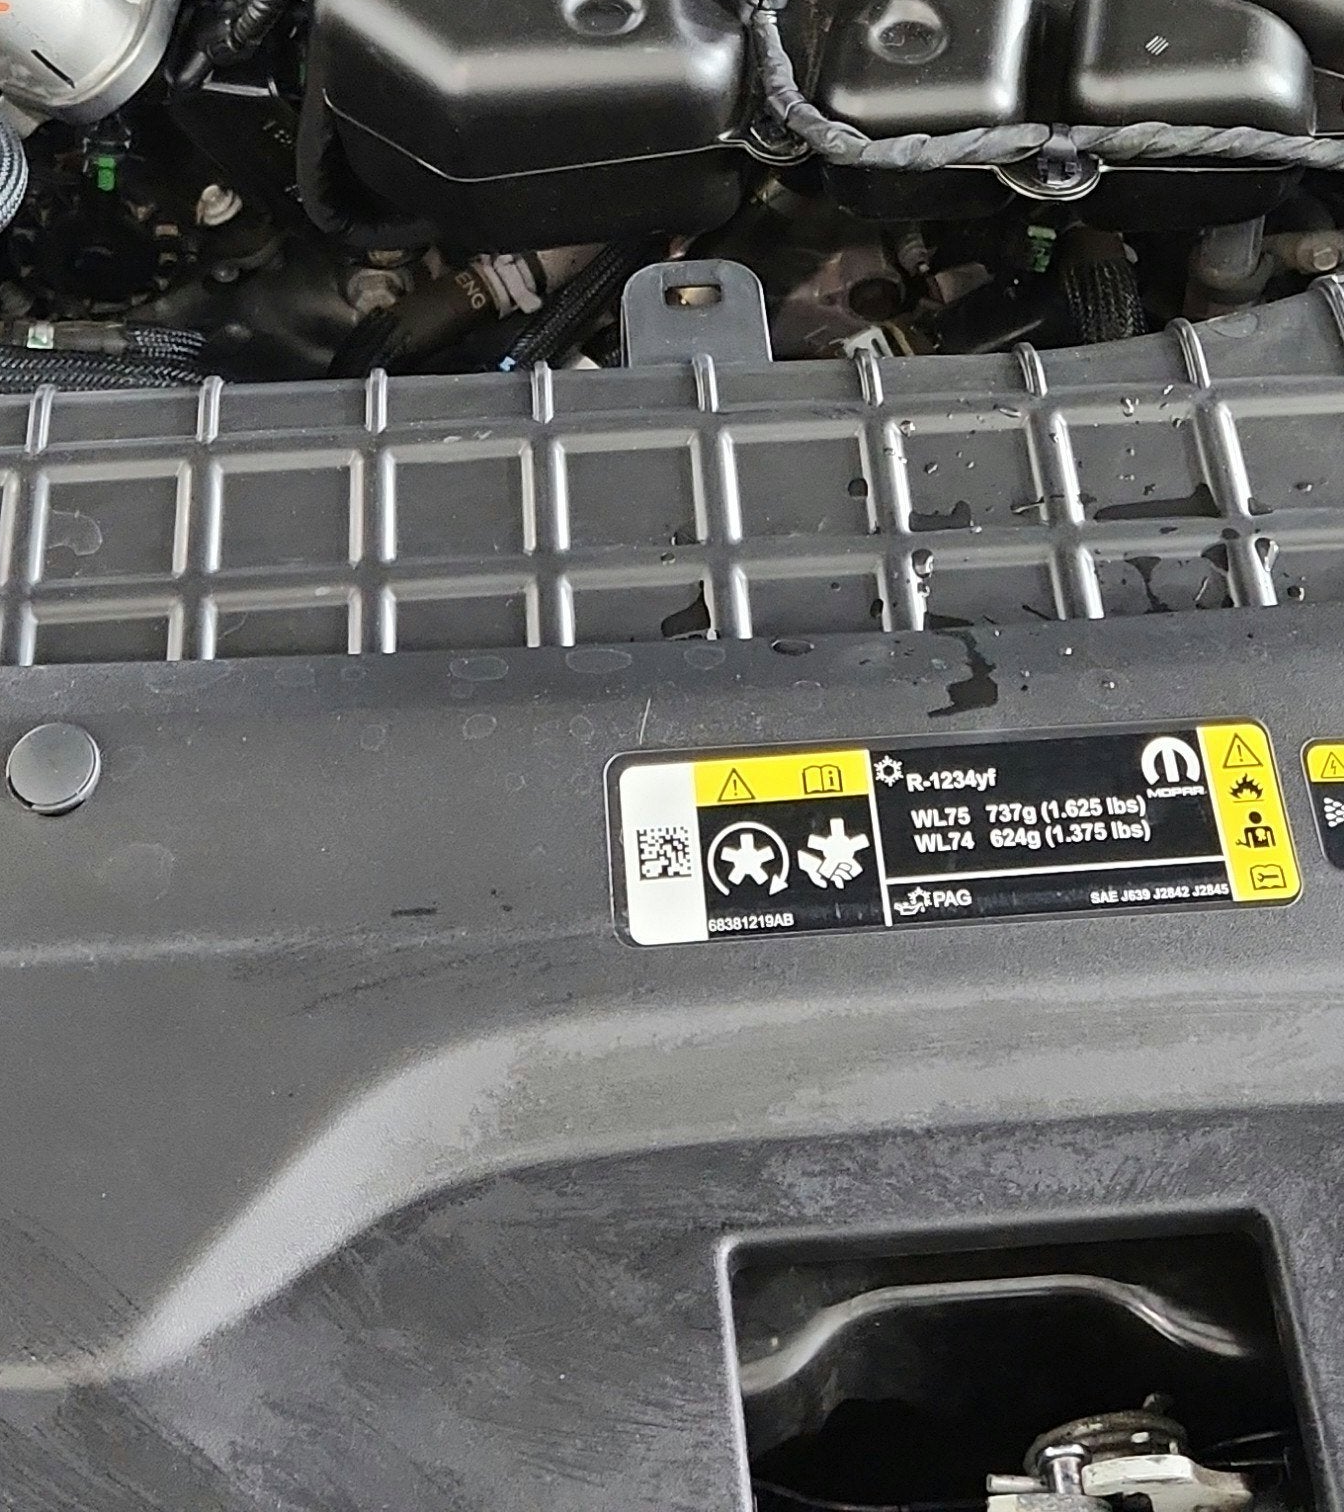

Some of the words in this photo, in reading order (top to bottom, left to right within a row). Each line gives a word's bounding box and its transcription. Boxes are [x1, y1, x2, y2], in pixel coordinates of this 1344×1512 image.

[454, 272, 486, 310] ENG
[906, 767, 996, 793] R-1234yf
[1146, 786, 1205, 799] MOPAR
[911, 806, 971, 828] WL75
[985, 803, 1038, 825] 737g
[1041, 798, 1103, 823] (1.625
[1105, 795, 1146, 818] lbs)
[914, 831, 975, 853] WL74
[990, 827, 1042, 850] 624g
[1045, 822, 1107, 848] (1.375
[1110, 819, 1151, 842] lbs)
[933, 889, 973, 908] PAG
[1090, 889, 1118, 904] SAE
[1120, 888, 1152, 902] J639
[1153, 885, 1190, 900] J2842
[1192, 882, 1232, 897] J2845
[707, 912, 795, 933] 68381219AB
